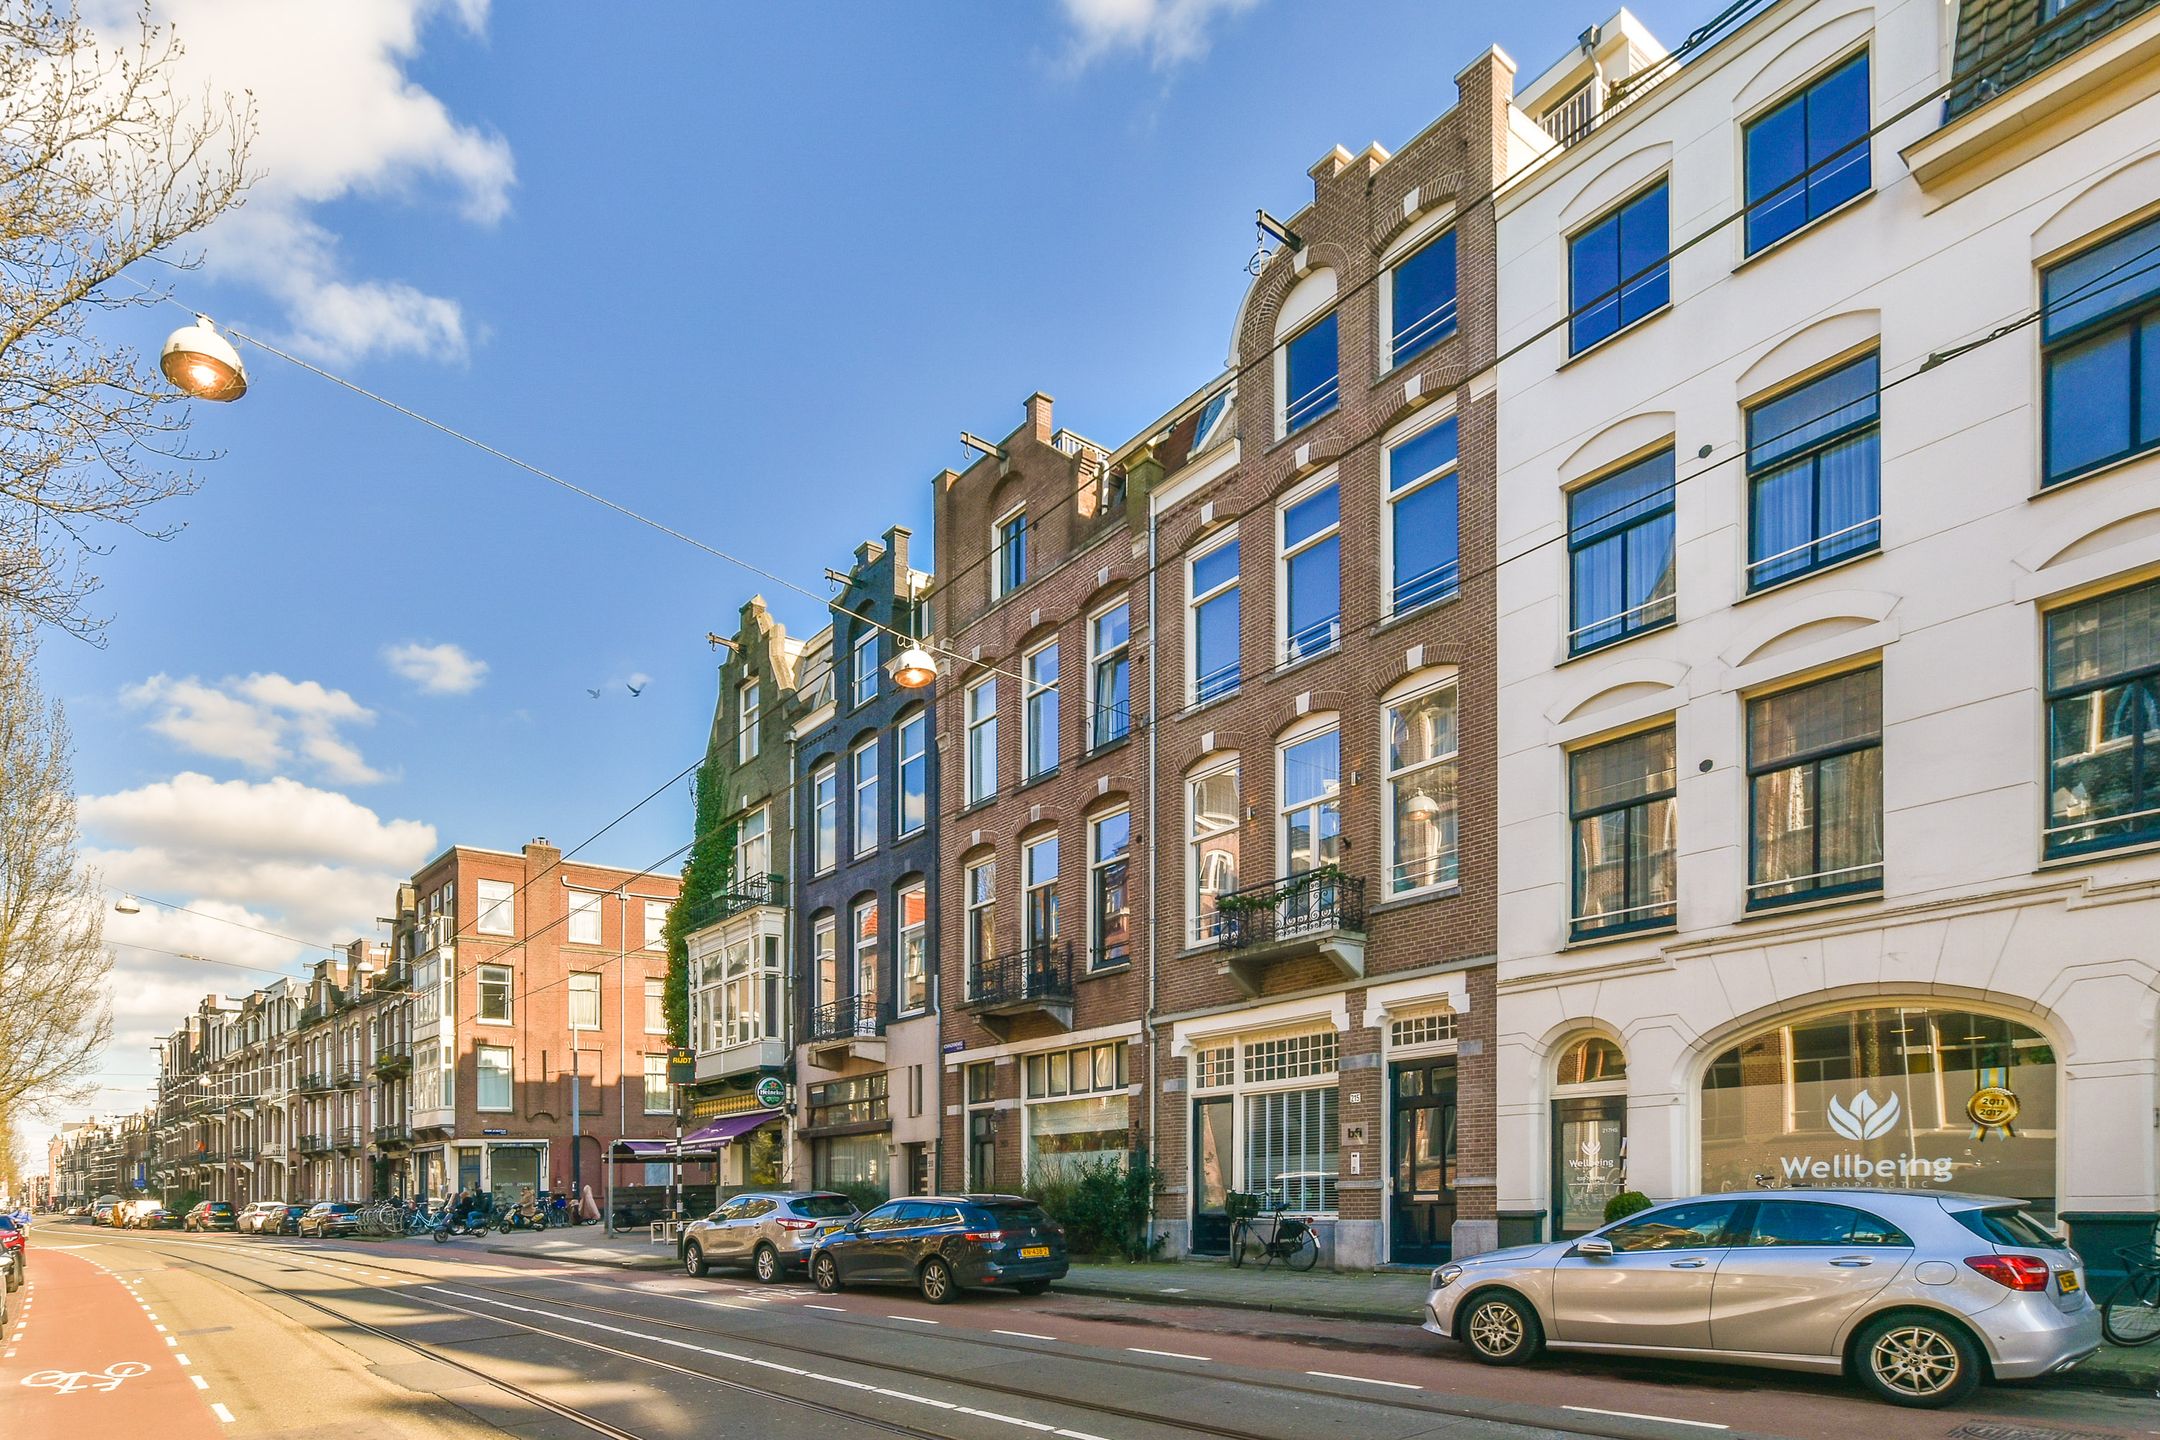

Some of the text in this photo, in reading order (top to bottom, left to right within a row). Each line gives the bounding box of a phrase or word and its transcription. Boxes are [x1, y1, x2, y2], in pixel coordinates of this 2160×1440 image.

[1982, 1098, 2005, 1106] 2011
[1980, 1108, 2002, 1116] 2017
[1569, 1159, 1614, 1168] Welleing
[1780, 1153, 1953, 1182] Wellbeing
